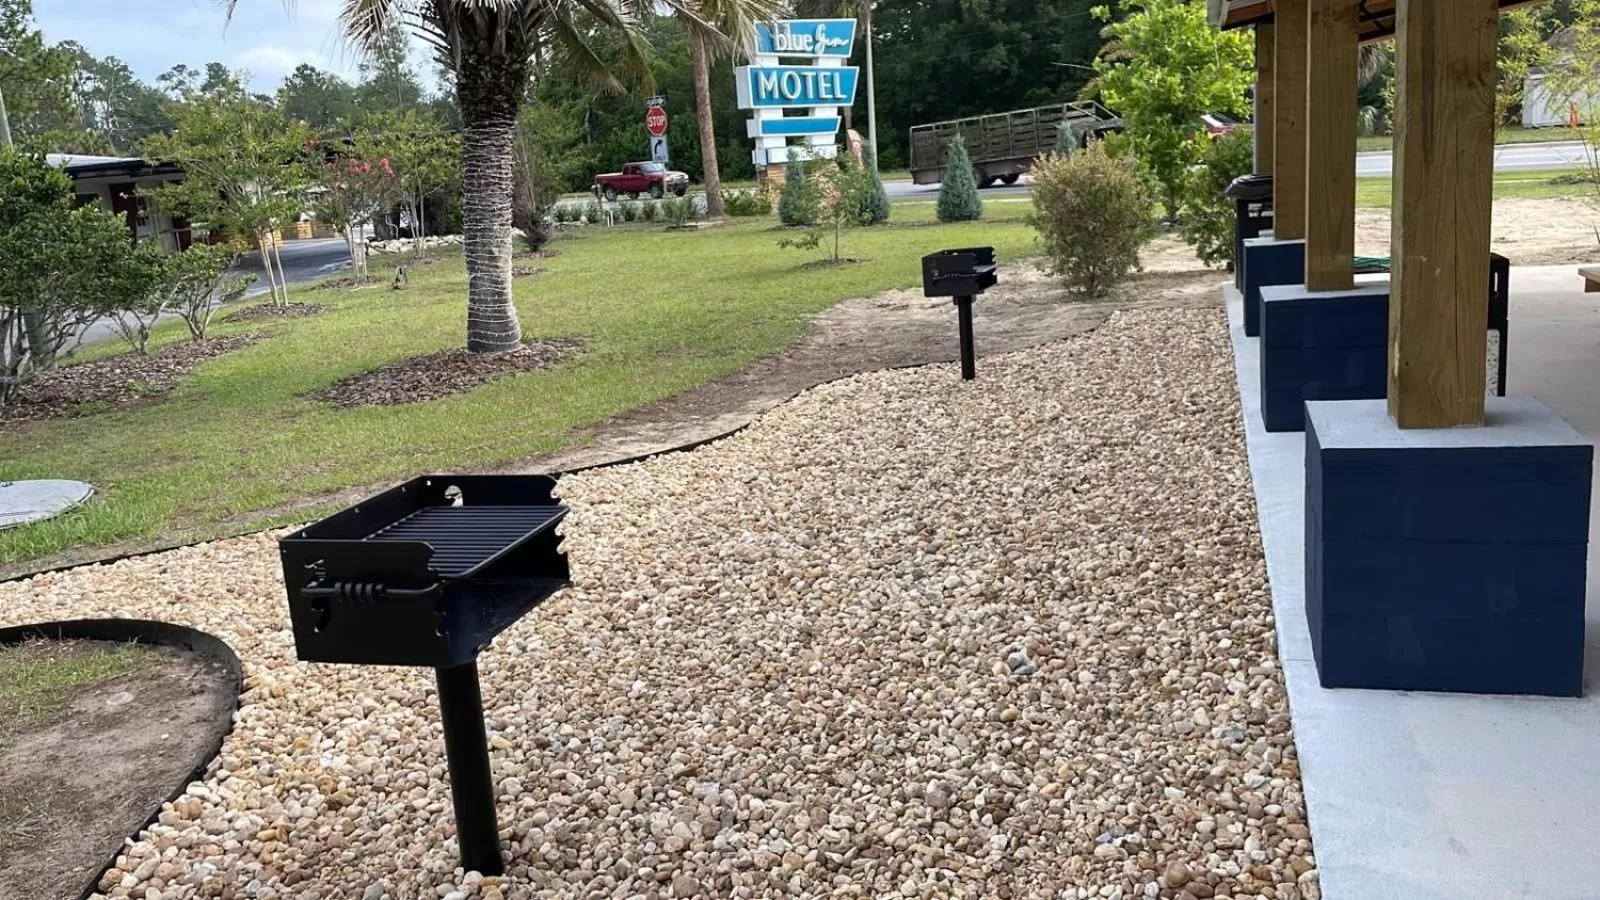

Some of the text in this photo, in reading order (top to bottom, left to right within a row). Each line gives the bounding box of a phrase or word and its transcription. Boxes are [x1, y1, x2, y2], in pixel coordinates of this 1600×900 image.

[773, 23, 814, 52] blue
[758, 70, 848, 99] MOTEL
[648, 115, 665, 127] STOP
